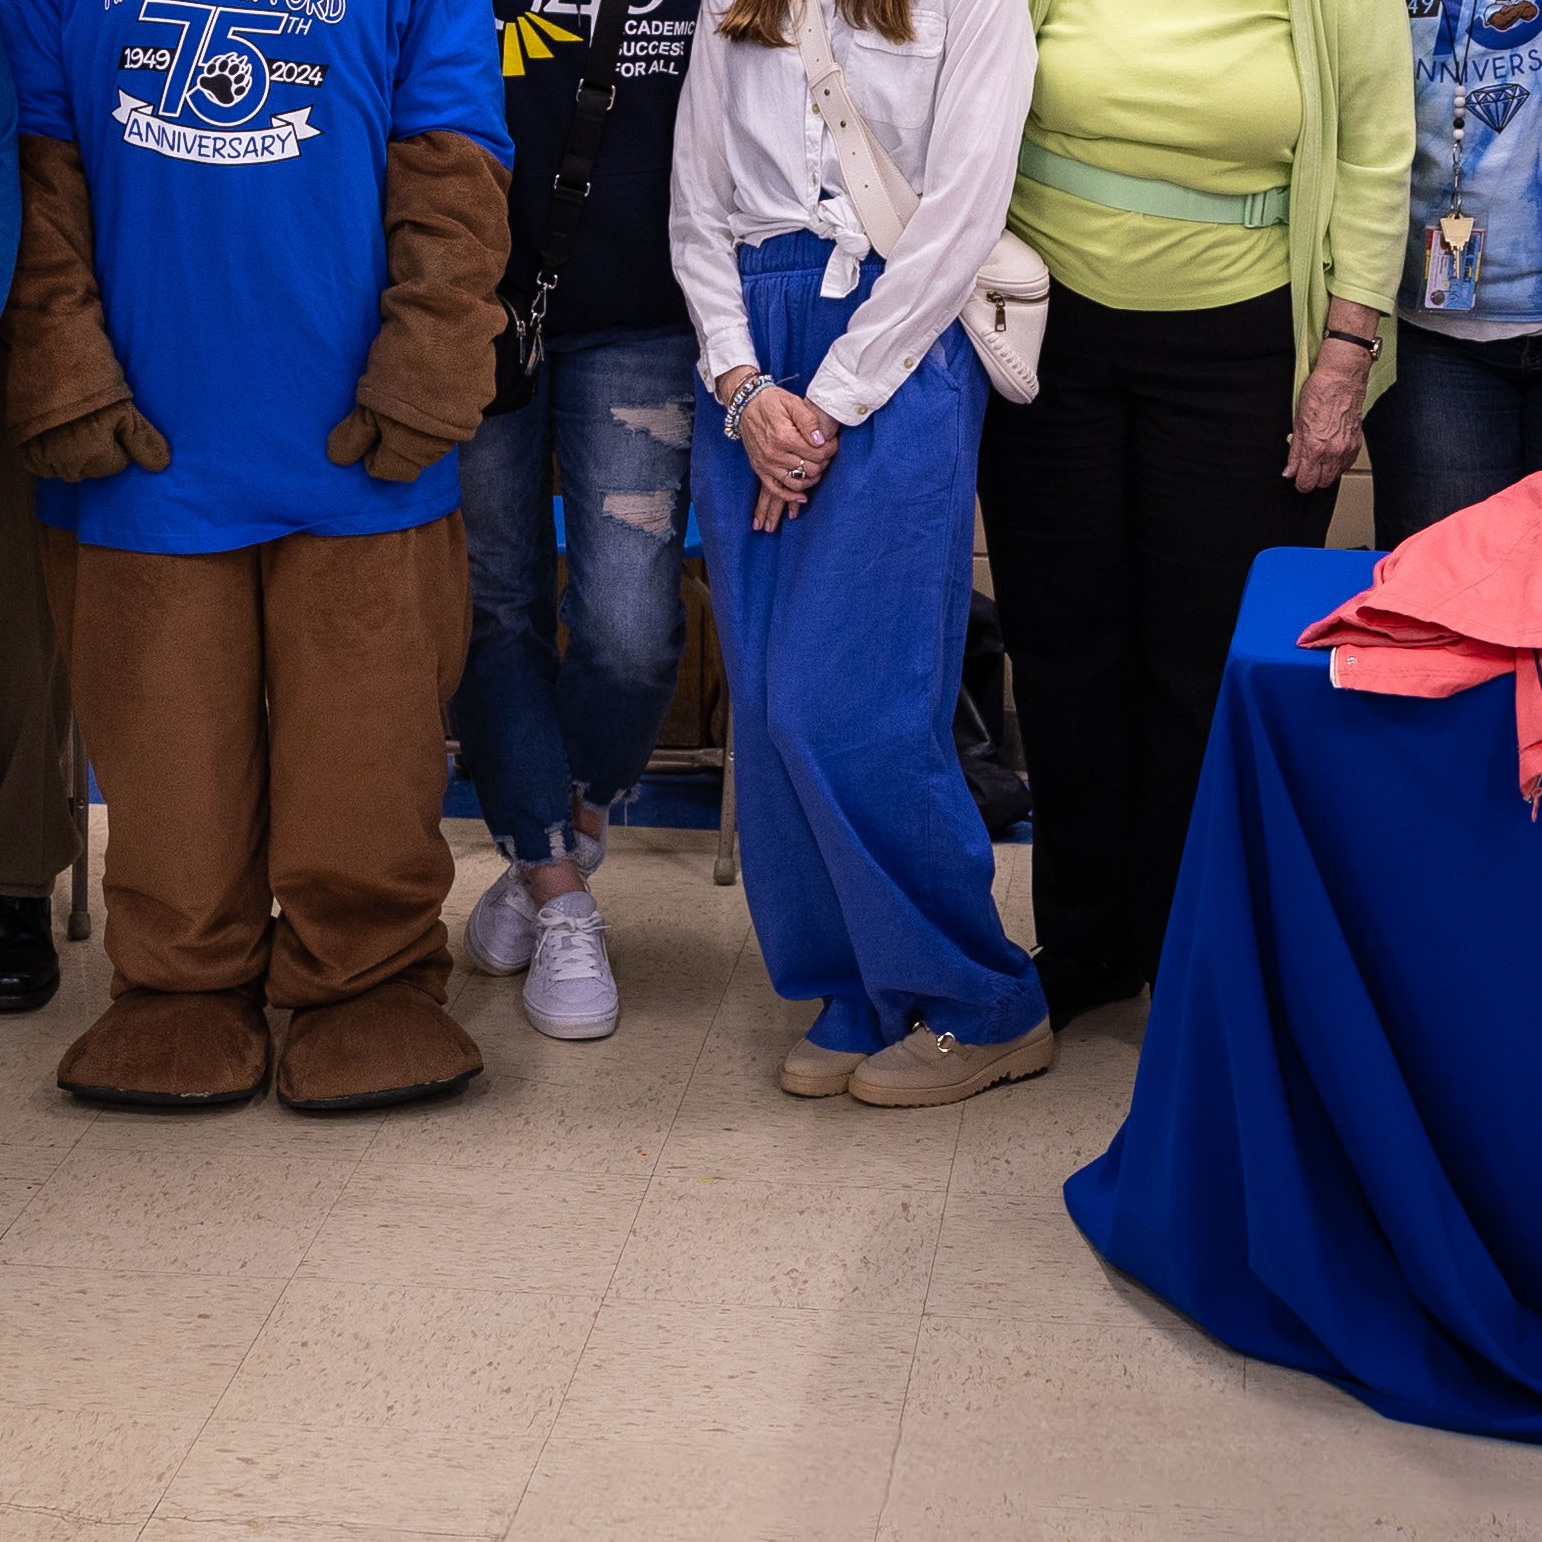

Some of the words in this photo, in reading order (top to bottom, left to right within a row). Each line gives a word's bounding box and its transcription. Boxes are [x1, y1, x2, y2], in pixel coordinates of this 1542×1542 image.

[622, 19, 696, 36] CADEMIC
[122, 46, 172, 71] 1949
[269, 61, 324, 87] 2024
[648, 59, 680, 76] ALL
[127, 117, 293, 160] ANNIVERSARY
